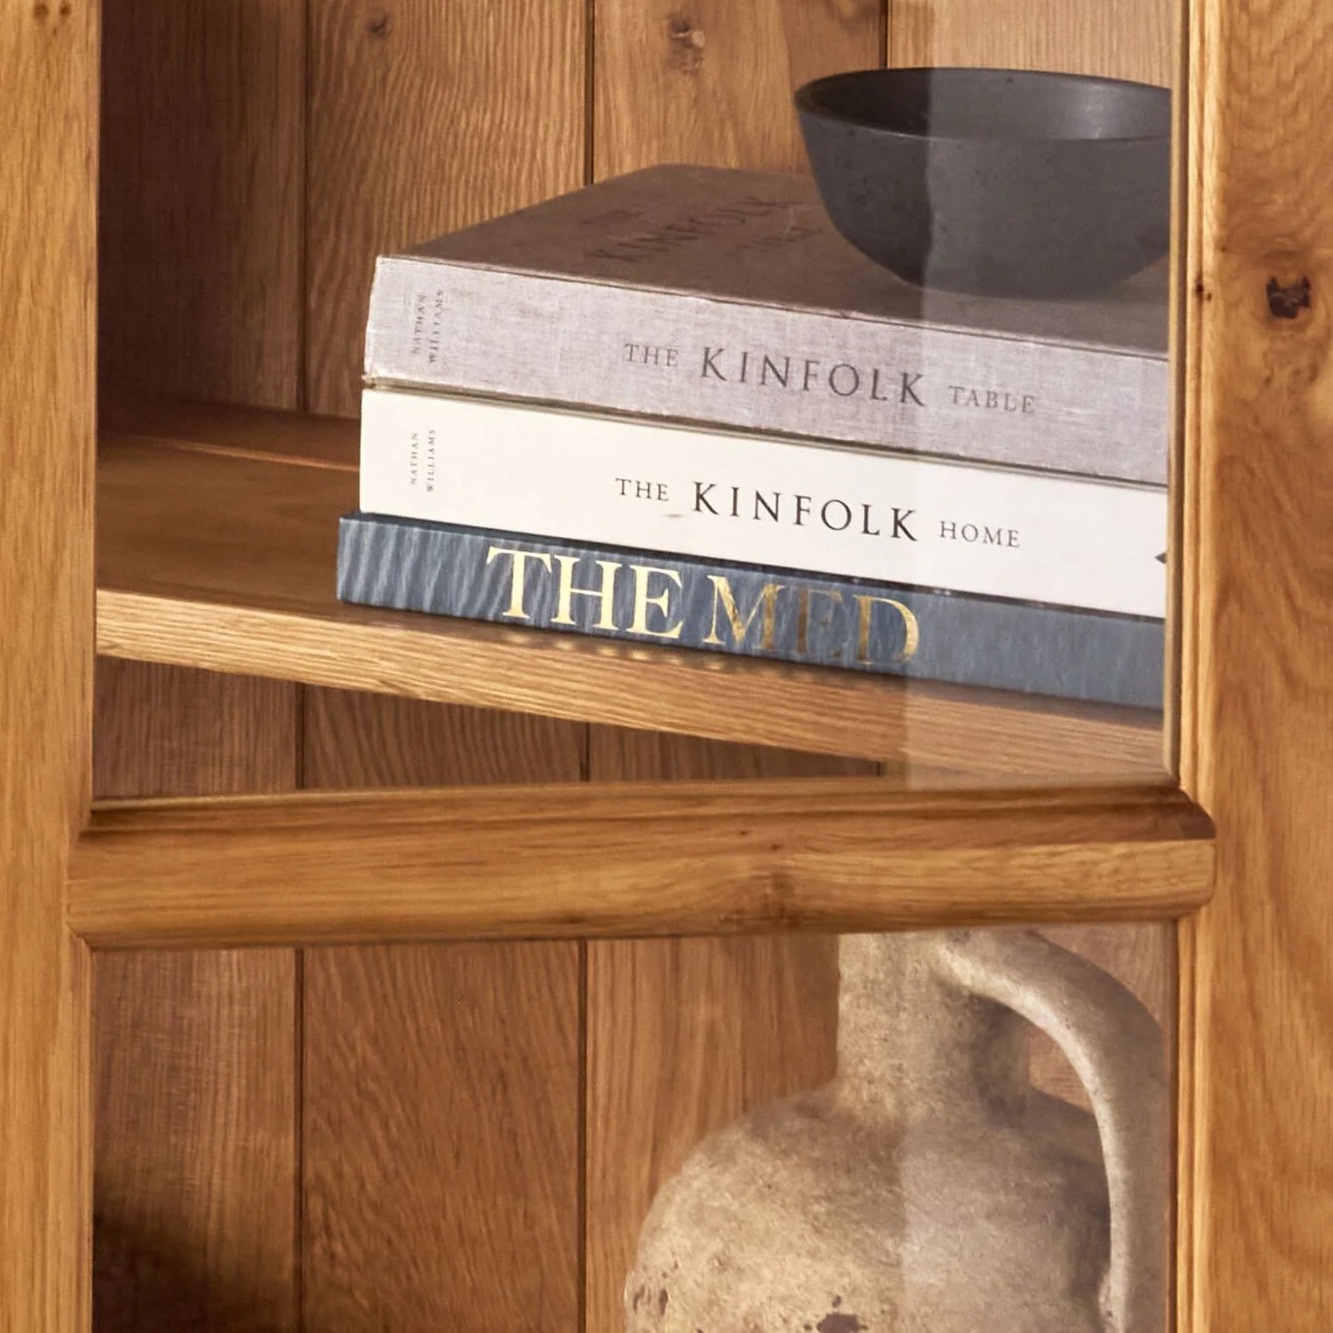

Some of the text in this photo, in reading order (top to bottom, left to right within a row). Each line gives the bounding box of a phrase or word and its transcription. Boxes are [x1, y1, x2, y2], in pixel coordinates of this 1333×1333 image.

[411, 294, 426, 354] NATHAN
[624, 343, 1035, 414] THE KINFOLK TABLE
[410, 432, 419, 485] NATHAN
[426, 429, 436, 493] WILLIAMS
[616, 478, 1020, 548] THE KINFOLK HOME
[486, 546, 919, 665] THE MED
